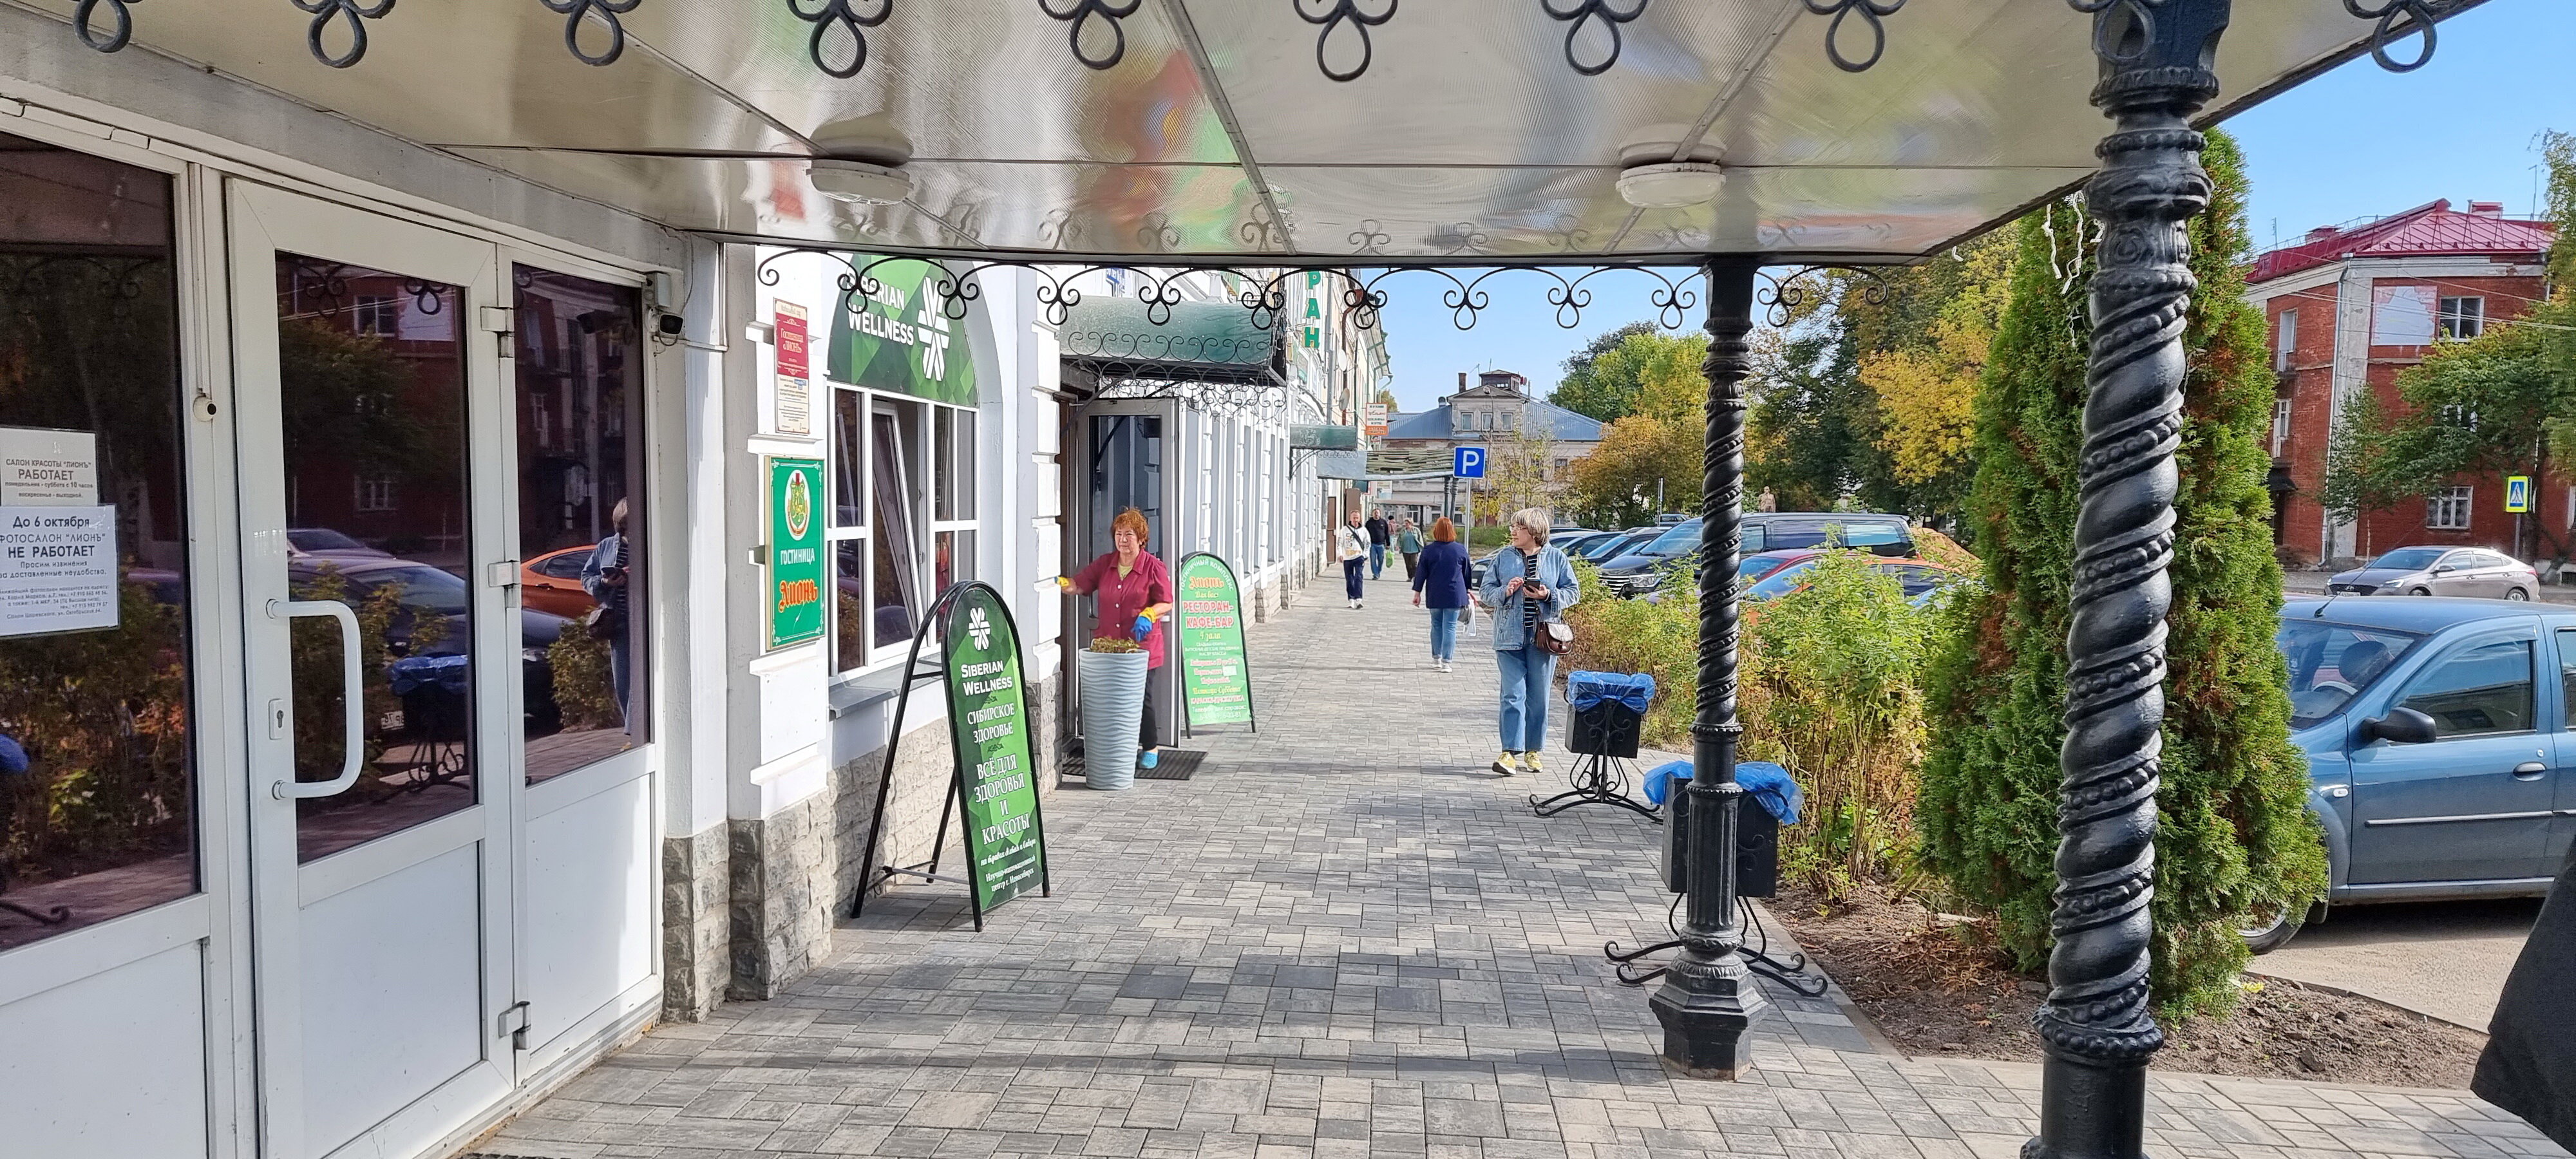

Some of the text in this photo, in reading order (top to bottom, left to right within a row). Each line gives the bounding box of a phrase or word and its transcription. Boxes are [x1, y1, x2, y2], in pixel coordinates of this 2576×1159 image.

[848, 303, 914, 345] WELLNESS
[18, 469, 74, 480] РАБОТАЕТ
[13, 516, 90, 529] До 6 октября
[8, 545, 95, 558] НЕ РАБОТАЕТ
[780, 548, 815, 565] ГОСТИНИЦА
[21, 561, 50, 569] Просим
[10, 570, 62, 578] доставленные
[1209, 560, 1235, 592] КОМПЛЕКС
[1182, 600, 1235, 613] РЕСТОРАН-
[1186, 616, 1235, 629] КАФЕ-БАР
[961, 660, 1004, 678] SIBERIAN
[963, 676, 1013, 696] WELLNESS
[967, 702, 1016, 725] СИБИРСКОЕ
[973, 722, 1014, 744] ЗДОРОВЬЕ
[976, 754, 1018, 780] ВСЁ ДЛЯ
[974, 773, 1025, 804] ЗДОРОВЬЯ
[999, 799, 1009, 816] И
[982, 813, 1030, 845] КРАСОТЫ
